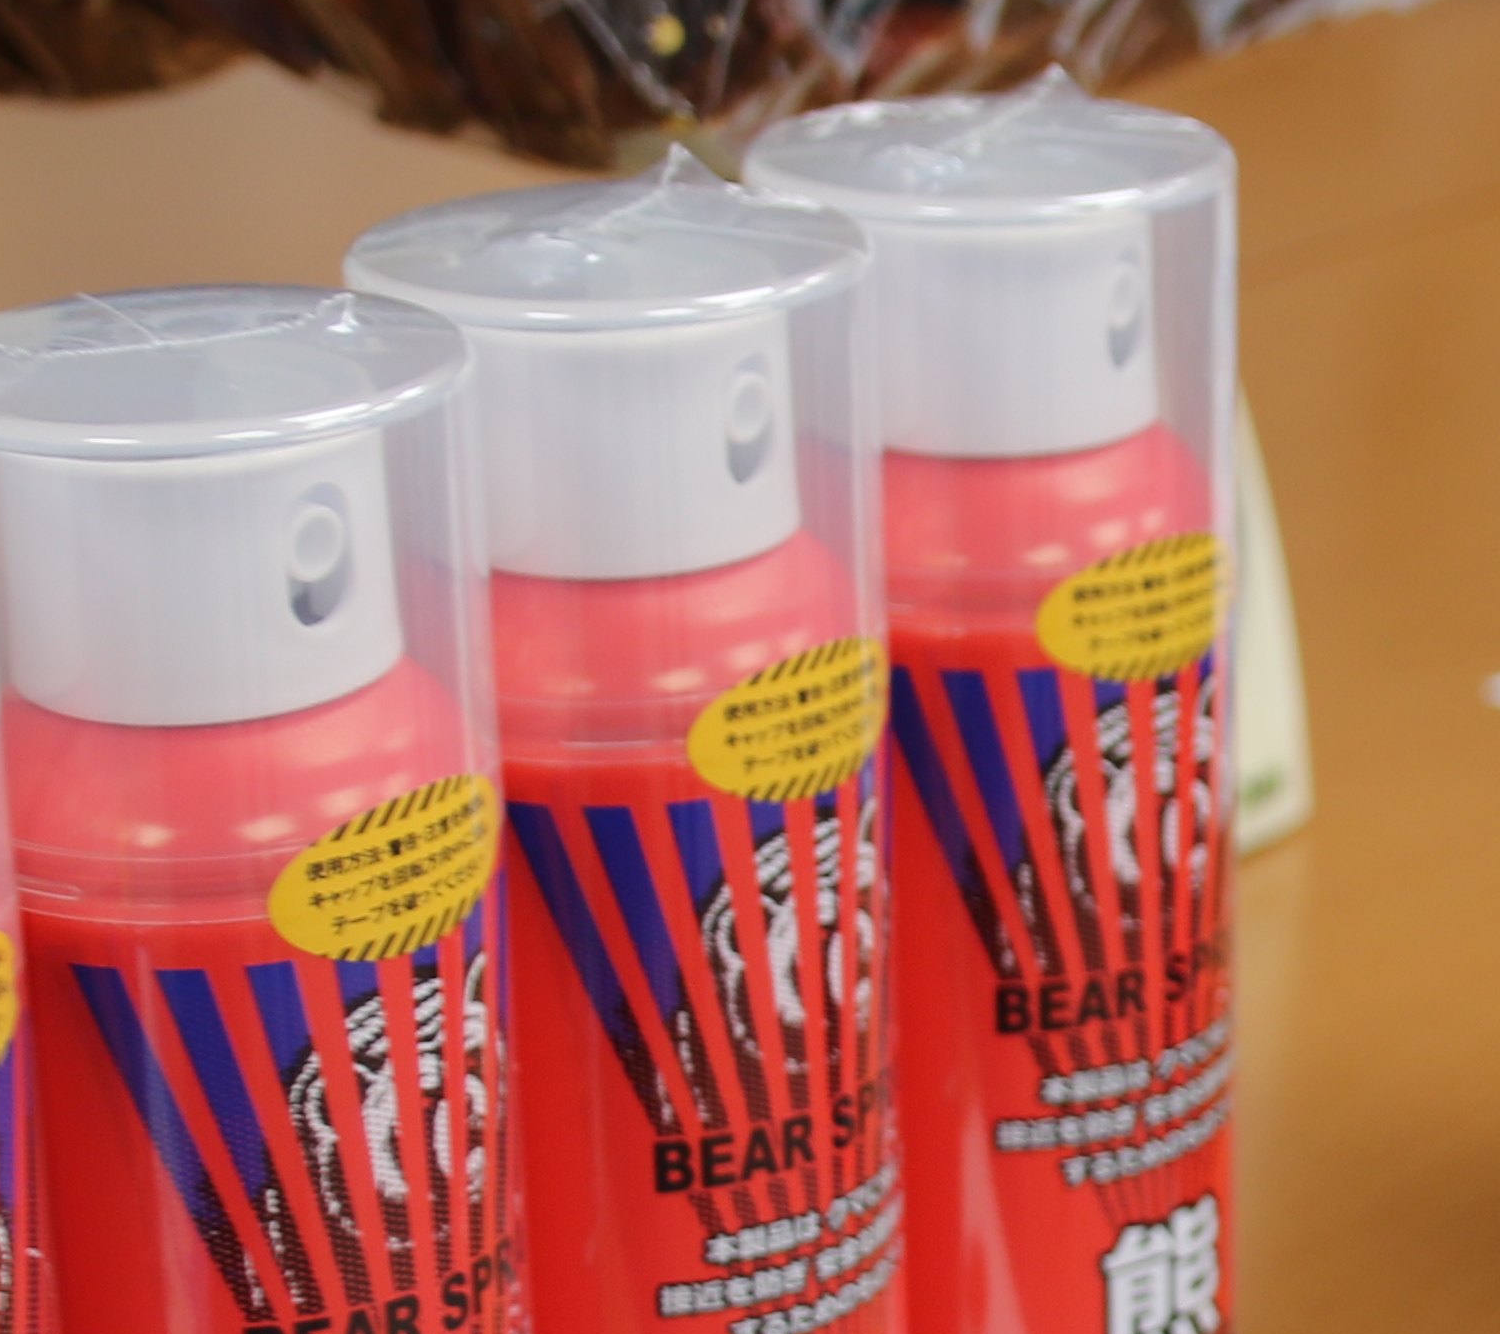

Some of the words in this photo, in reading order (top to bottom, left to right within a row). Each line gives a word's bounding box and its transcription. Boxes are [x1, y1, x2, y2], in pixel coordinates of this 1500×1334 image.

[996, 971, 1146, 1034] BEAR
[654, 1117, 814, 1193] BEAR
[442, 1237, 518, 1331] SPR
